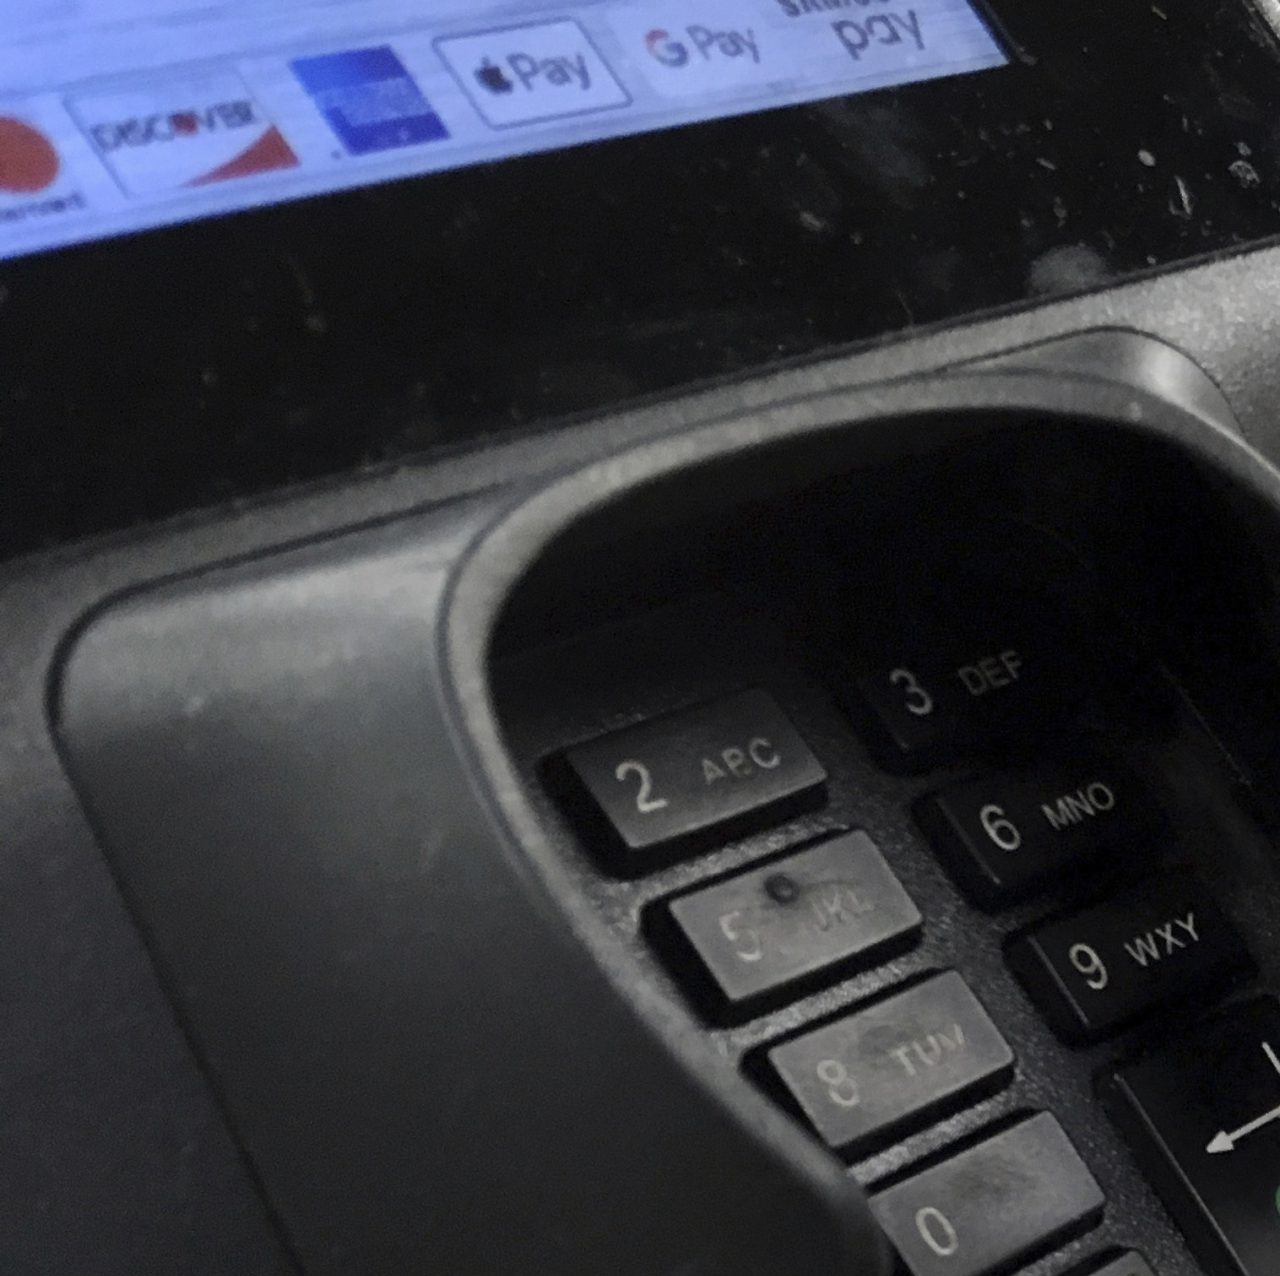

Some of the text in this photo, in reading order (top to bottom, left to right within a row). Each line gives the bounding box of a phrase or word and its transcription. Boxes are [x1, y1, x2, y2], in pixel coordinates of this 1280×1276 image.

[831, 9, 925, 60] pay
[508, 52, 592, 91] Pay
[889, 650, 1022, 716] 3 DEF
[615, 759, 669, 813] 2
[979, 782, 1116, 852] 6 MNO
[718, 910, 763, 962] 5
[1068, 912, 1200, 990] 9 WXY
[815, 1058, 859, 1108] 8
[914, 1205, 959, 1257] 0
